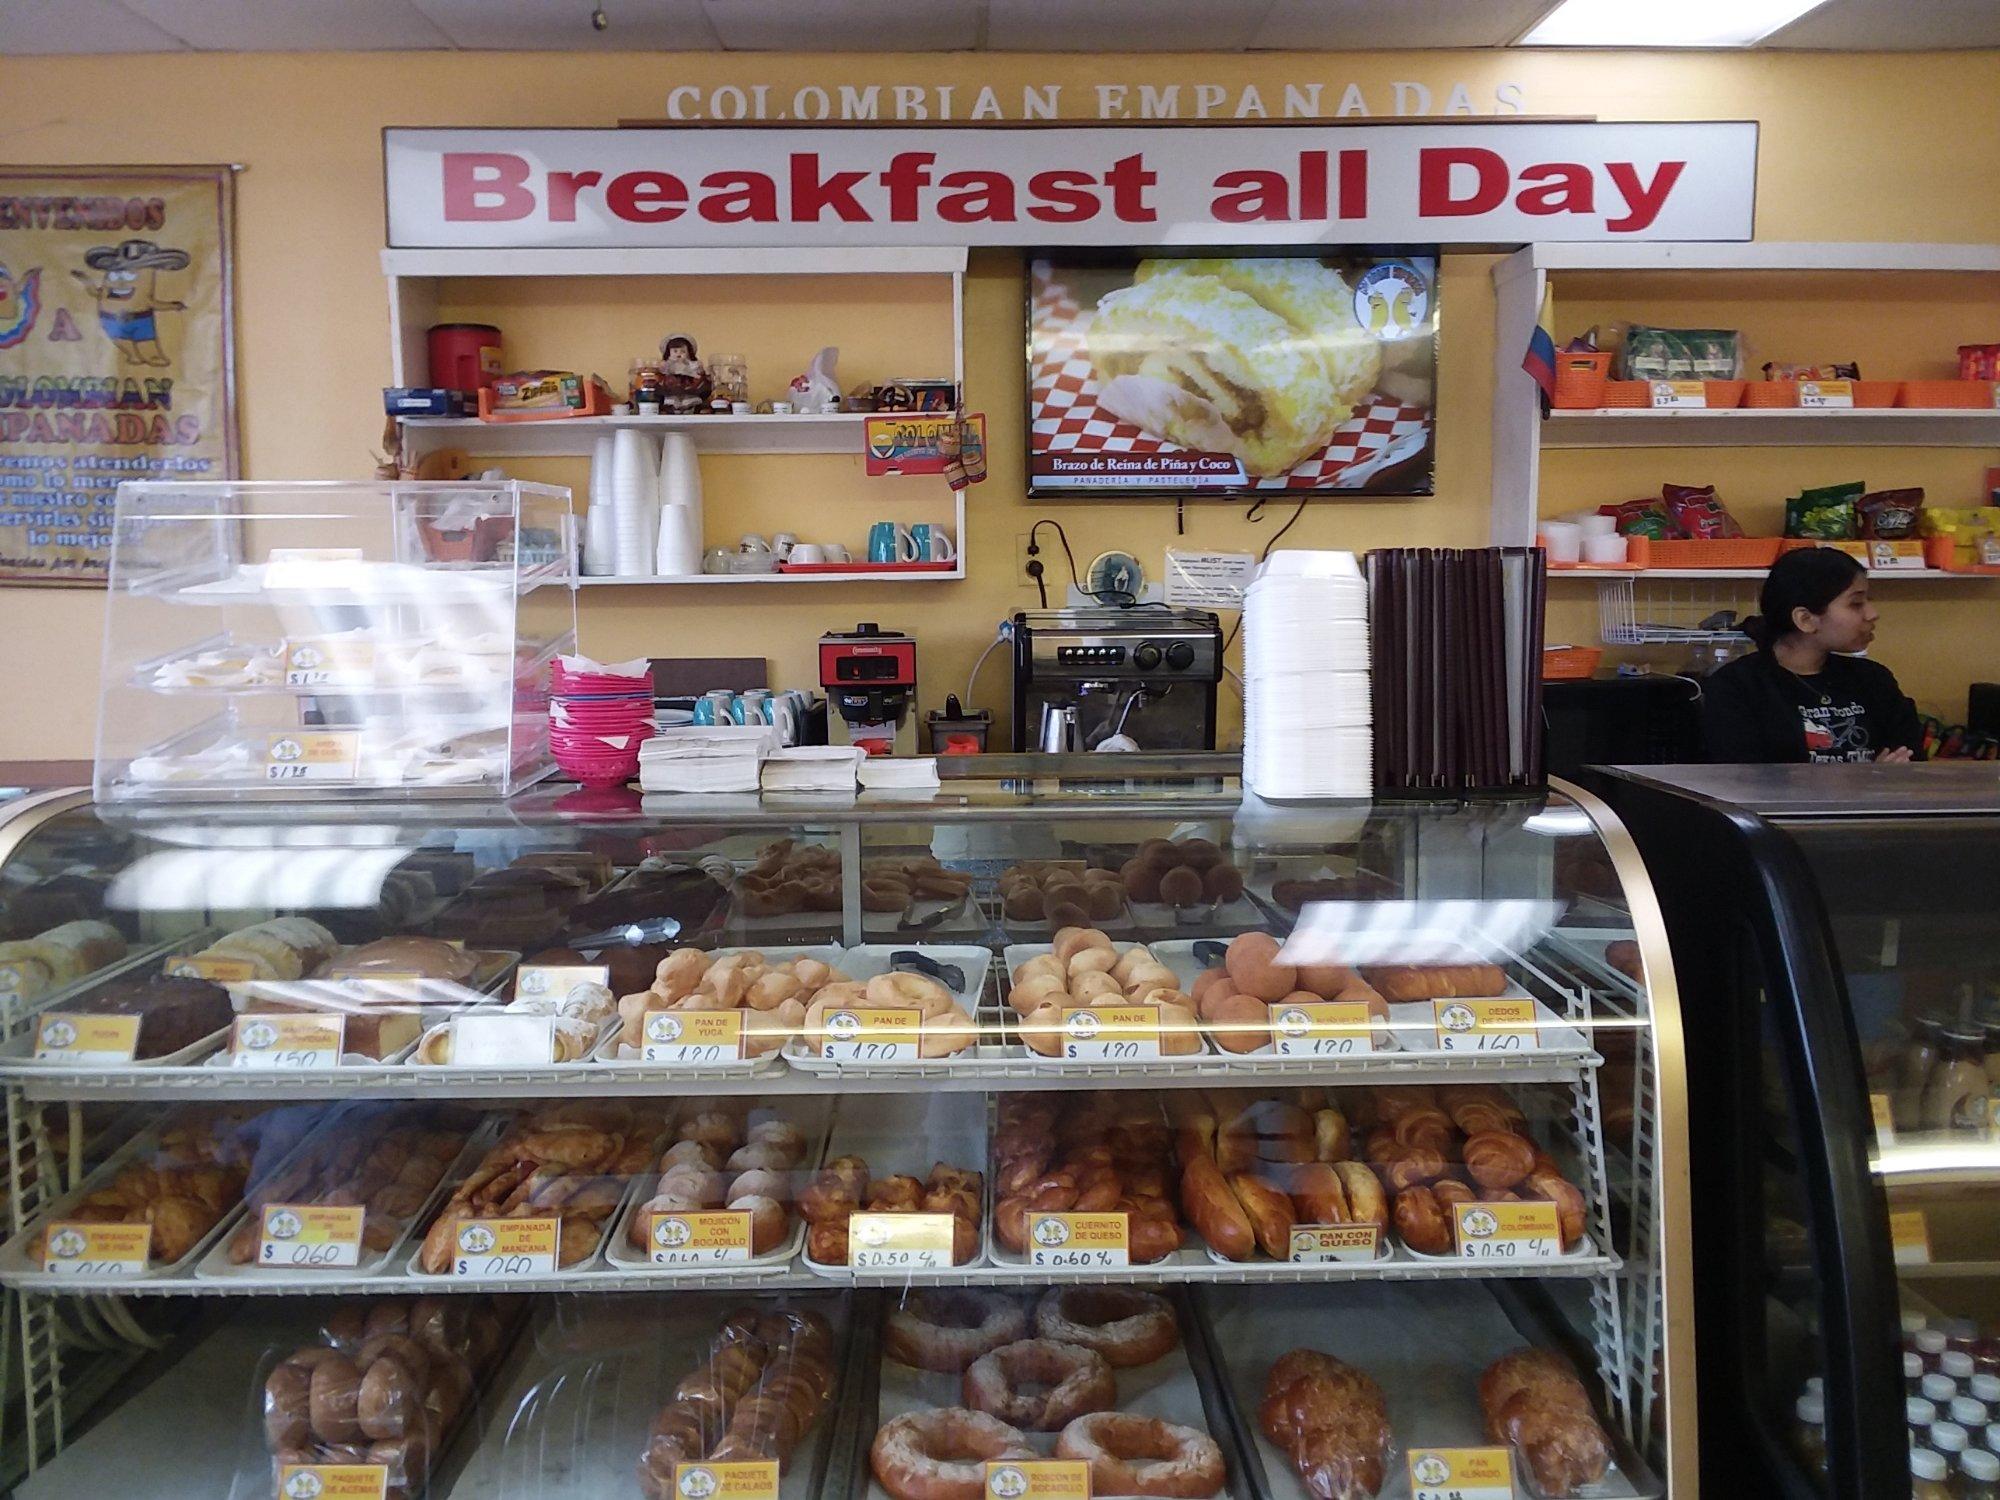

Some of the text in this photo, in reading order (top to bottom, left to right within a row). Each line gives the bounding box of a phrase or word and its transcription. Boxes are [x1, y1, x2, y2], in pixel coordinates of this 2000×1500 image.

[666, 81, 1527, 121] COLOMBIAN EMPANADAS
[441, 147, 1687, 232] Breakfast all Day
[1053, 458, 1231, 473] Brazo de Reina de Piña y Coco
[1488, 1008, 1520, 1016] DEDOS
[694, 1018, 728, 1027] PAN DE
[873, 1017, 907, 1025] PAN DE
[698, 1028, 723, 1036] YUCA
[1444, 1037, 1453, 1050] $
[825, 1045, 834, 1058] $
[1068, 1045, 1077, 1058] $
[1280, 1042, 1290, 1055] $
[646, 1049, 656, 1061] $
[500, 1224, 552, 1232] EMPANADA
[1075, 1221, 1121, 1229] CUERNITO
[519, 1235, 531, 1243] DE
[1090, 1232, 1122, 1240] QUESO
[1320, 1231, 1372, 1240] PAN CON
[693, 1238, 746, 1246] BOCADILLO
[1320, 1239, 1372, 1247] QUESO
[264, 1244, 273, 1259] $
[458, 1260, 468, 1275] $
[724, 1471, 768, 1480] PAQUETE
